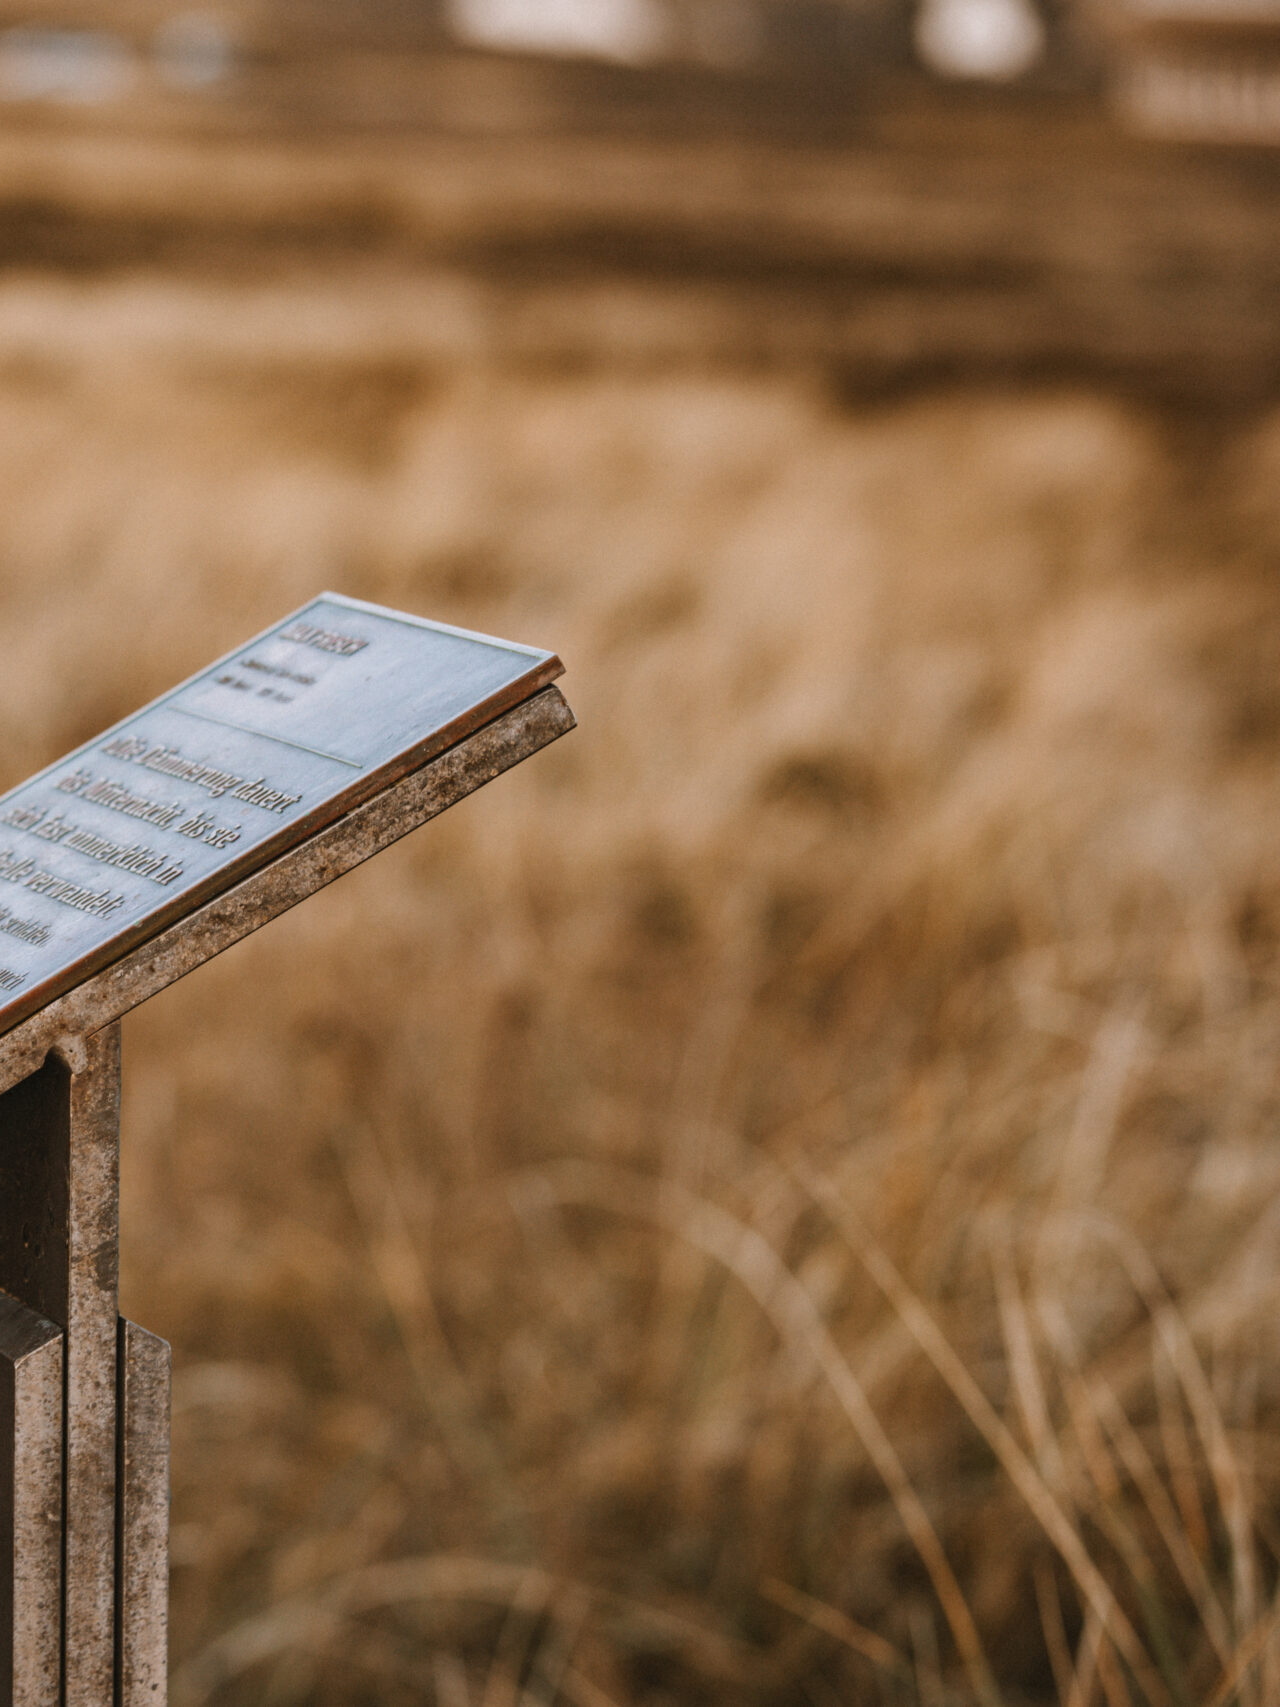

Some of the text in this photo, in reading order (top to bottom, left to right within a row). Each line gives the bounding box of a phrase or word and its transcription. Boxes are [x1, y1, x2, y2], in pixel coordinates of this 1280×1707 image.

[53, 769, 242, 848] bis Mitternacht, bis sie
[136, 746, 243, 798] Dämmerung
[232, 780, 300, 812] dauert
[2, 805, 186, 885] sich fast unmerklich in
[21, 871, 123, 920] verwandelt.
